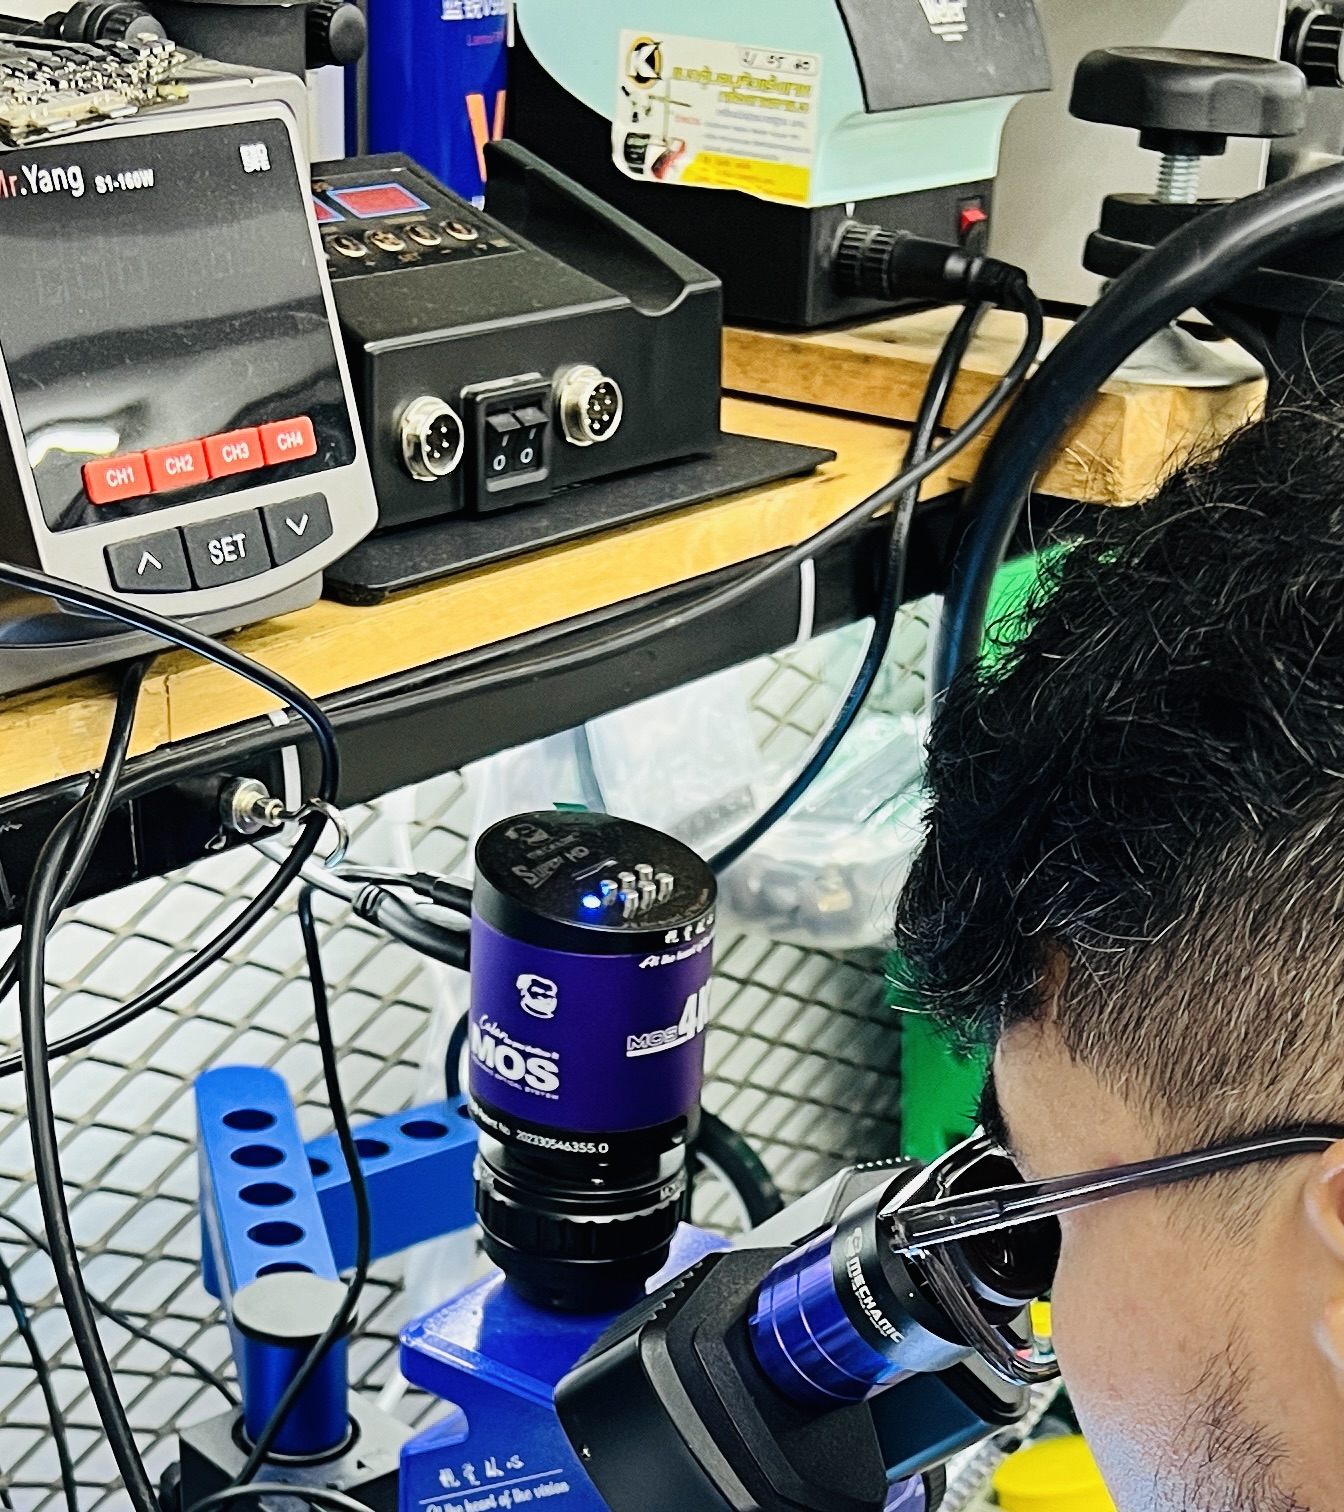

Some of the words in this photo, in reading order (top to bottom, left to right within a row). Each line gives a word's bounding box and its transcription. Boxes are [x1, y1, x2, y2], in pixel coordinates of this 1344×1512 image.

[106, 468, 135, 488] CH1
[165, 456, 194, 475] CH2
[222, 443, 250, 462] CH3
[277, 431, 304, 451] CH4
[207, 533, 246, 565] SET
[470, 1022, 560, 1092] MOS
